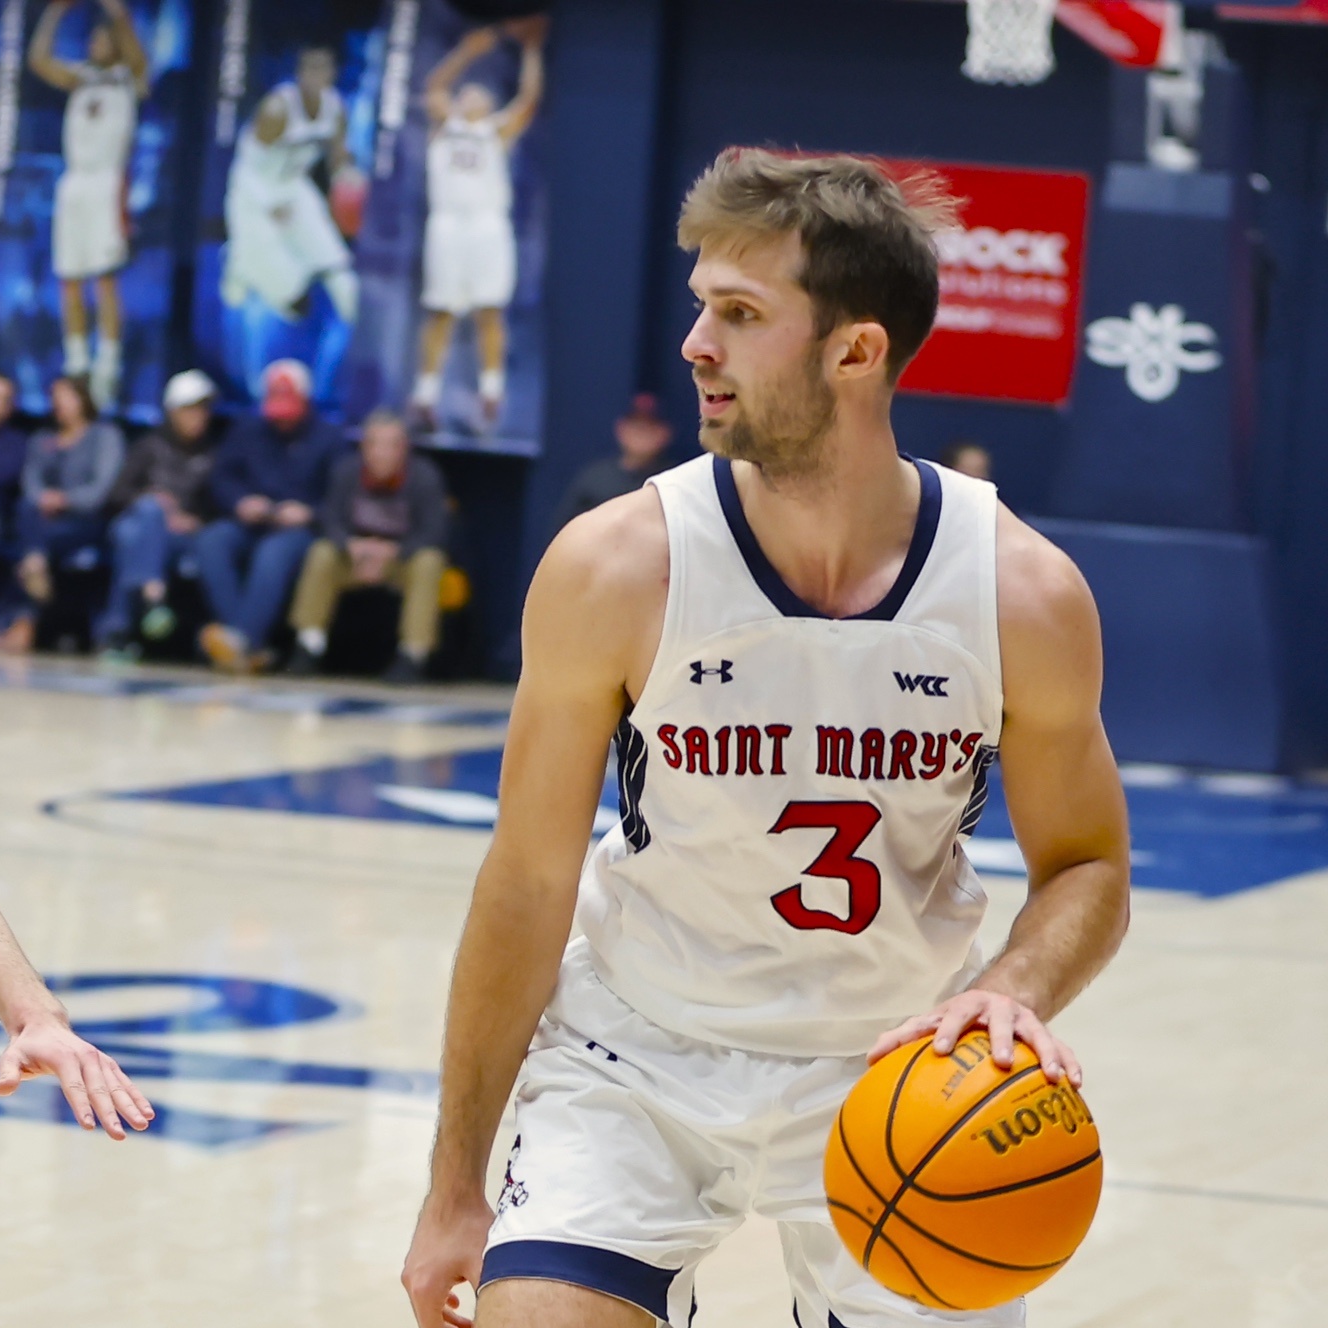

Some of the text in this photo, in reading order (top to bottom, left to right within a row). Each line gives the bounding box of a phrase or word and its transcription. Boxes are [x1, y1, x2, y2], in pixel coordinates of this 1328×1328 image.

[892, 671, 950, 697] WCC
[657, 723, 985, 780] SAINT MARY'S
[767, 800, 882, 935] 3
